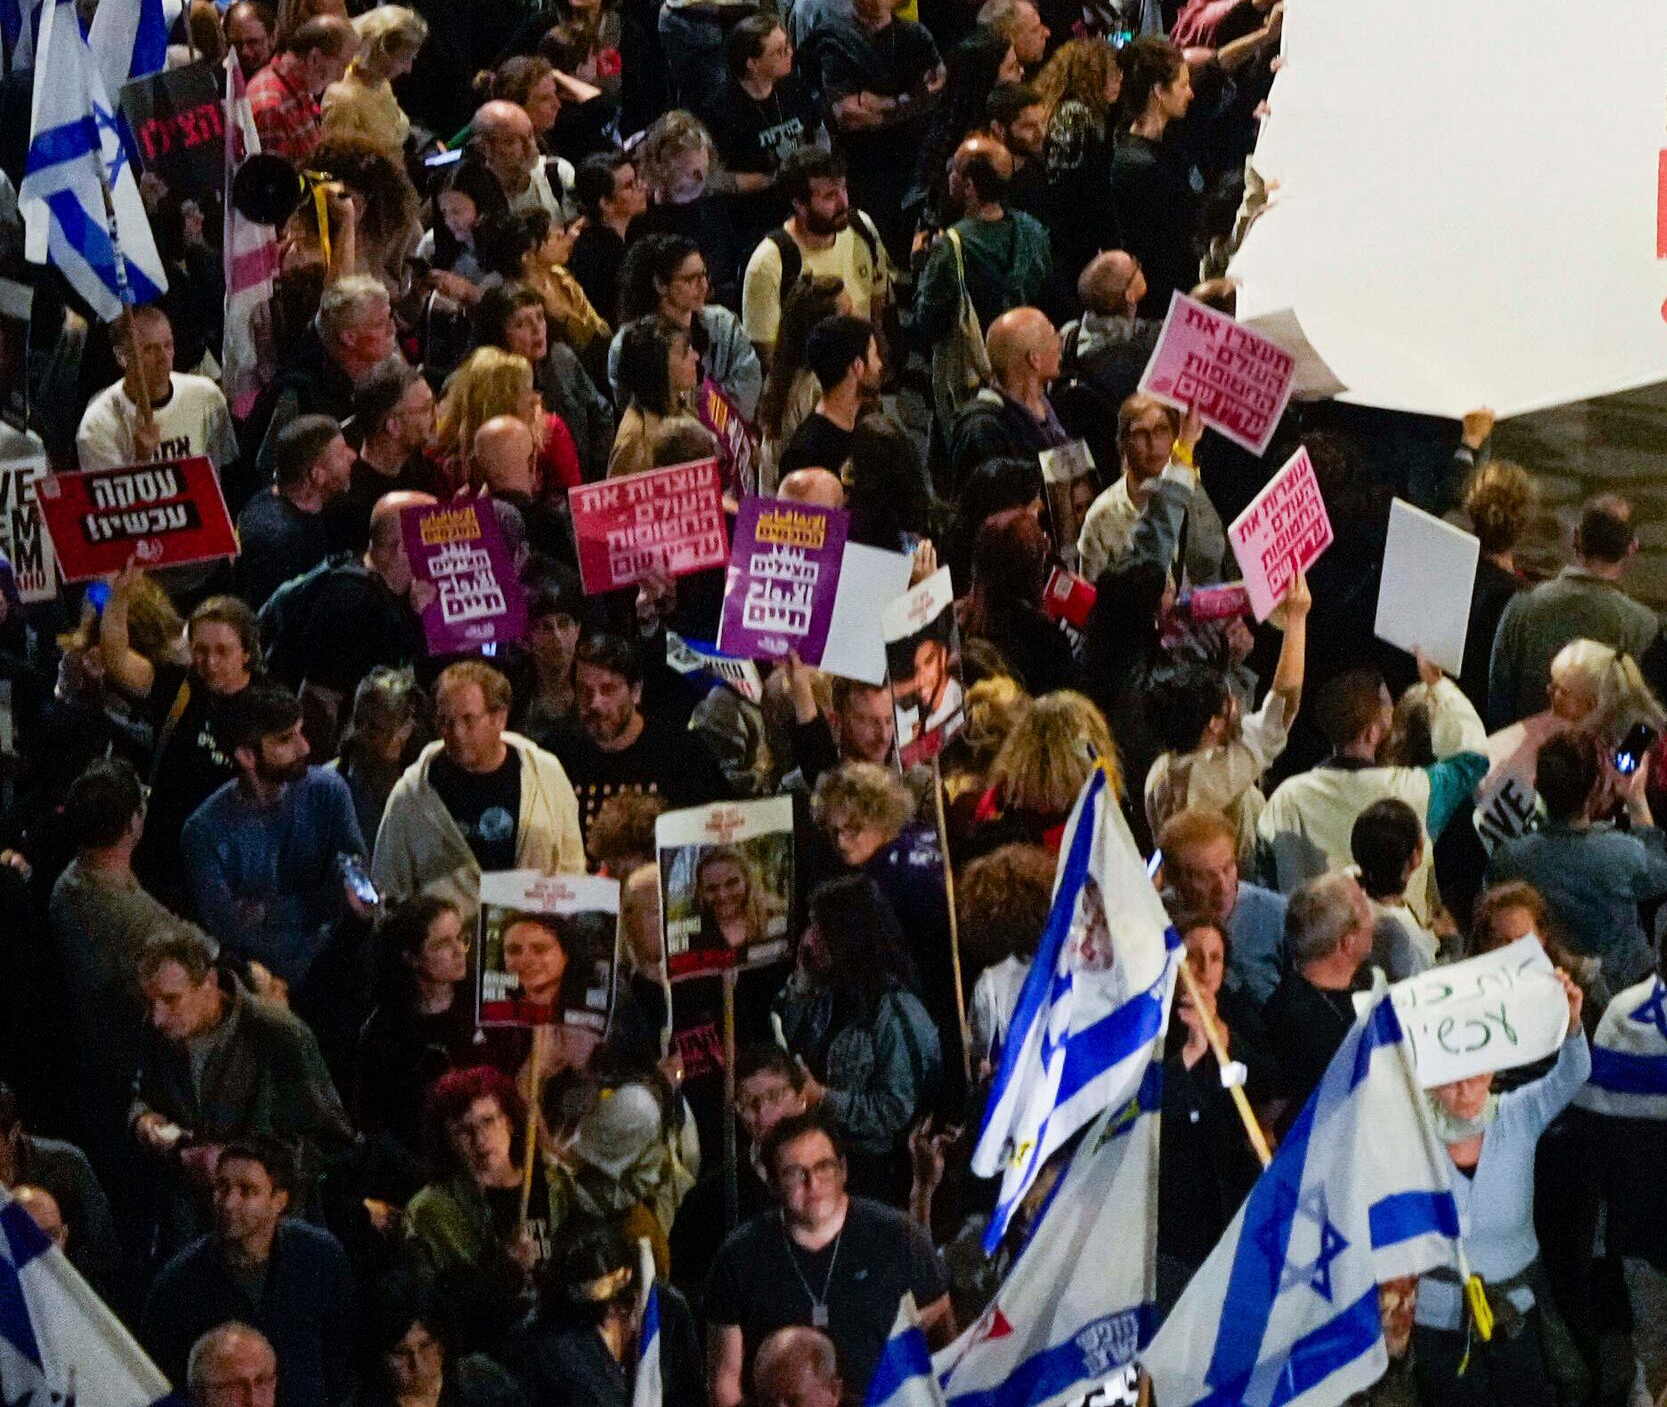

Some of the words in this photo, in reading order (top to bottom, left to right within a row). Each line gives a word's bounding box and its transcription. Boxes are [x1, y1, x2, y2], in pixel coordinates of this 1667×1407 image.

[1186, 307, 1220, 340] את
[1185, 351, 1276, 412] החטופות
[1217, 345, 1283, 394] העולם
[91, 468, 178, 508] עסקה
[580, 488, 619, 513] את
[626, 464, 713, 502] עוצרות
[1262, 457, 1307, 518] עוצרות
[635, 490, 717, 524] העולם
[1271, 475, 1317, 532] העולם
[86, 504, 188, 541] עכשיו!
[606, 512, 720, 549] החטופות
[1239, 510, 1260, 544] את
[1260, 496, 1321, 571] החטופות
[754, 559, 815, 579] מצילים
[447, 593, 503, 617] חיים
[748, 605, 807, 629] חיים
